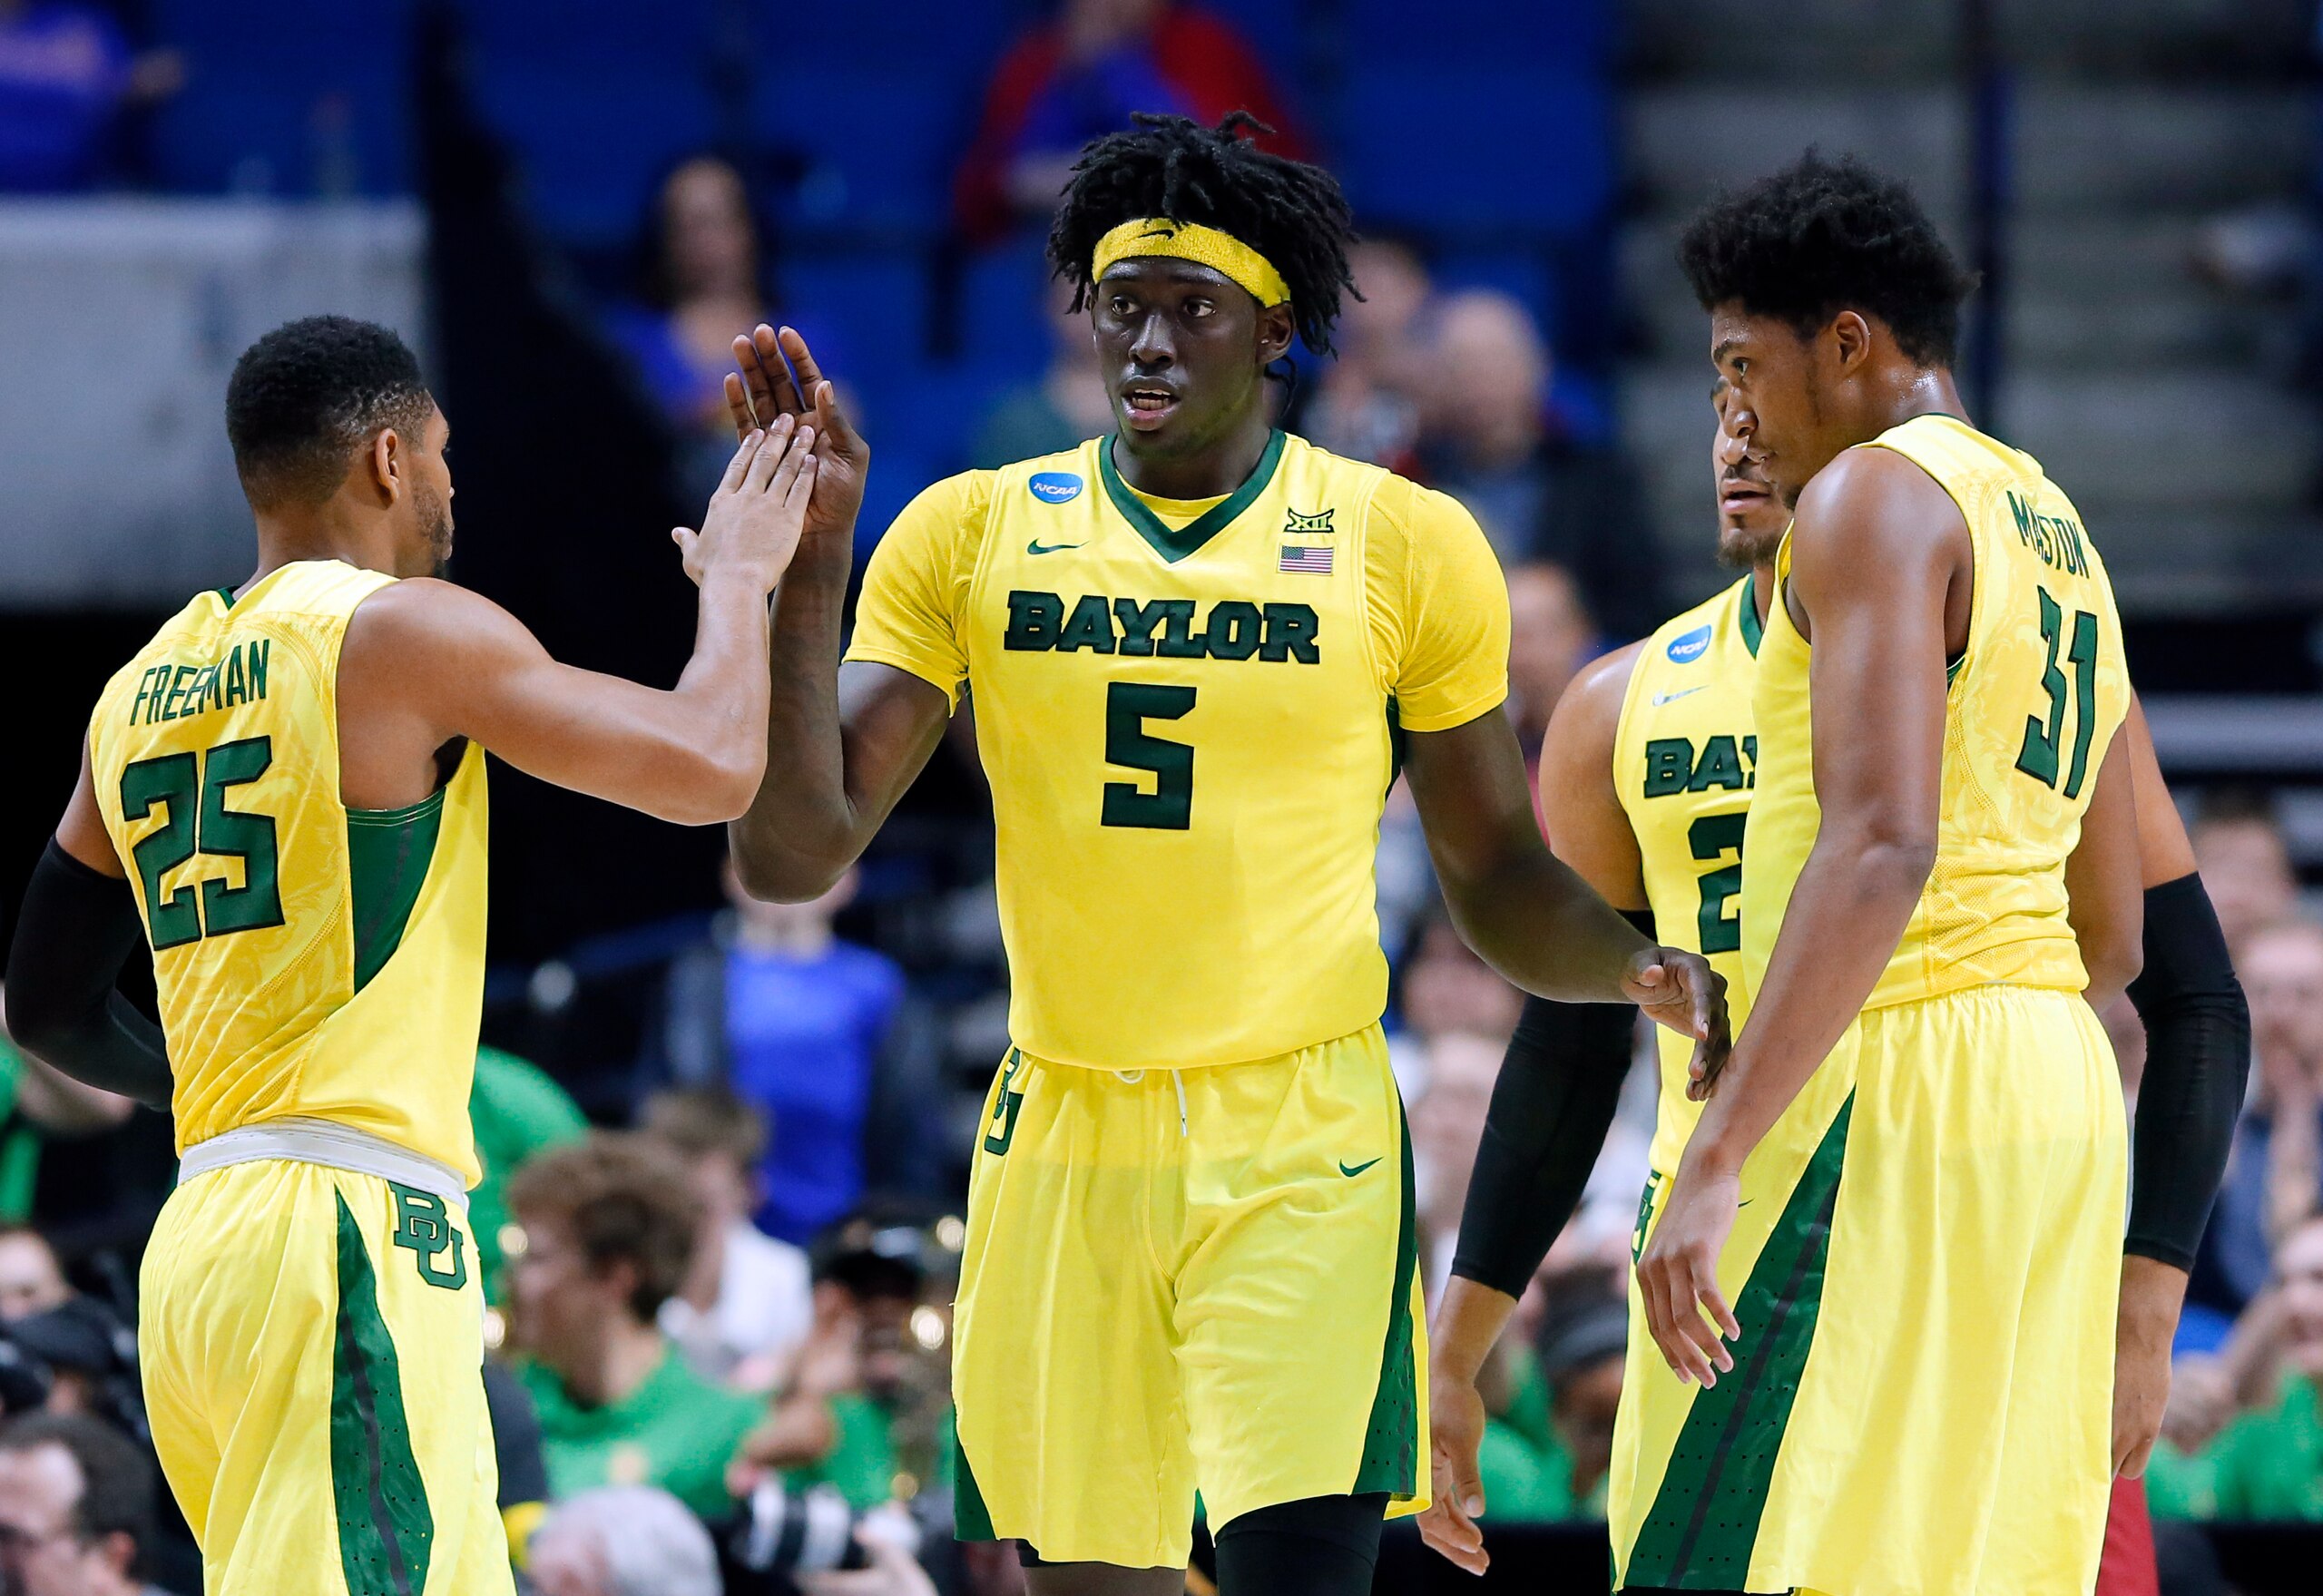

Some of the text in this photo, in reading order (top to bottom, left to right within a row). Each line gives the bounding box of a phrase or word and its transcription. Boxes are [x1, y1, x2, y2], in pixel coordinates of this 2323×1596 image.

[1033, 482, 1078, 495] NCAA
[2005, 490, 2090, 579] MASTON
[1004, 590, 1320, 665] BAYLOR
[130, 638, 270, 726] FREEMAN
[2015, 584, 2098, 800] 31
[1101, 681, 1198, 831] 5
[120, 735, 286, 952] 25
[387, 1180, 467, 1291] BU
